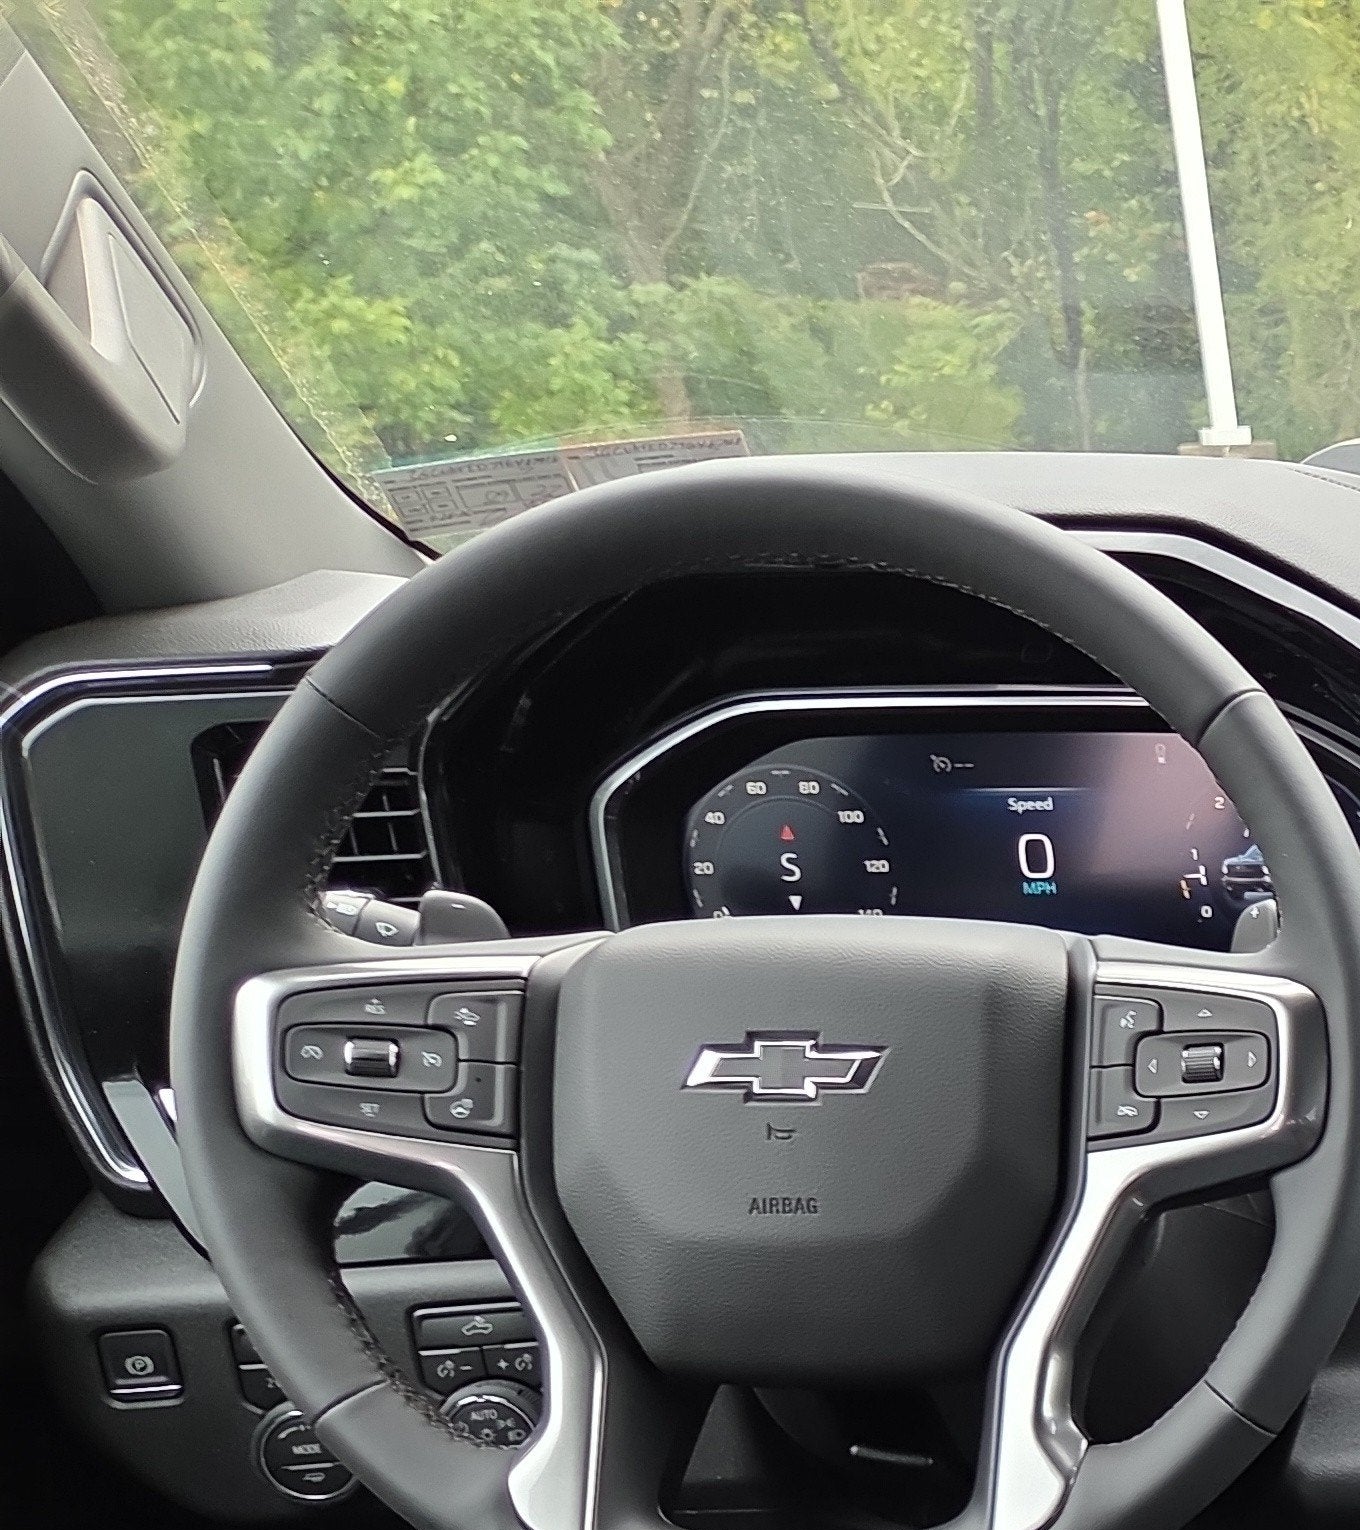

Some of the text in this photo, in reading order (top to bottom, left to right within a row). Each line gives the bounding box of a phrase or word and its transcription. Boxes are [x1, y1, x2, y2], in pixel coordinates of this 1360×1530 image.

[745, 781, 767, 796] 60
[798, 781, 820, 796] 80
[1007, 797, 1054, 814] Speed
[1214, 796, 1225, 810] 2
[704, 811, 726, 825] 40
[837, 809, 865, 825] 100
[1017, 833, 1055, 879] 0
[693, 861, 714, 875] 20
[780, 852, 802, 882] S
[863, 859, 890, 874] 120
[1022, 881, 1057, 895] MPH
[1200, 904, 1213, 918] 0
[749, 1197, 819, 1215] AIRBAG
